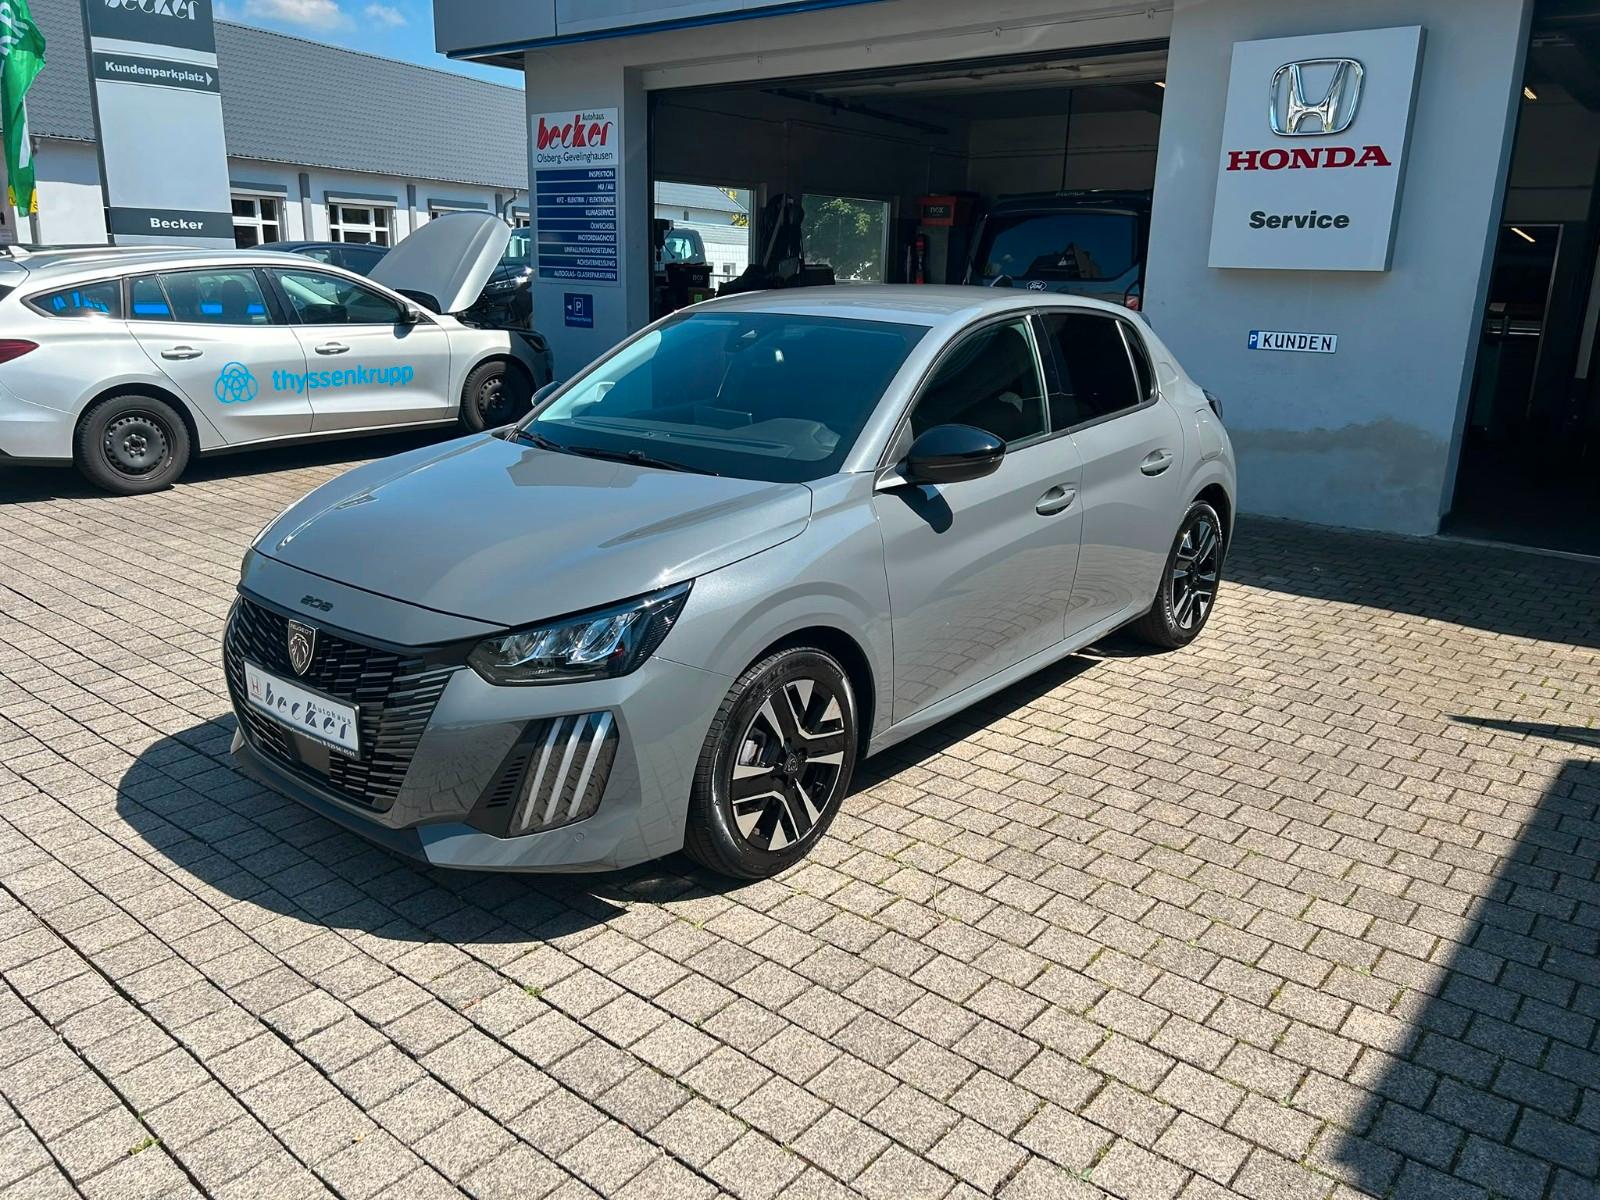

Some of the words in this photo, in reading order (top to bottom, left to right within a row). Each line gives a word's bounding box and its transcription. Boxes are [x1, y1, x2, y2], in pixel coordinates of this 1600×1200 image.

[104, 0, 199, 20] ecker
[105, 61, 204, 83] Kundenparkplatz
[582, 112, 605, 121] Autohaus
[537, 114, 614, 150] becker
[537, 152, 613, 165] Olsberg-Gevelinghausen
[1226, 145, 1391, 170] HONDA
[588, 170, 614, 178] INSPEKTION
[150, 218, 204, 230] Becker
[1249, 210, 1349, 229] Service
[575, 301, 582, 312] P
[1249, 334, 1257, 346] P
[1263, 333, 1333, 351] KUNDEN
[272, 363, 414, 394] thyssenkrupp
[300, 594, 334, 612] 208
[265, 681, 352, 740] becker
[311, 703, 352, 725] Autohaus
